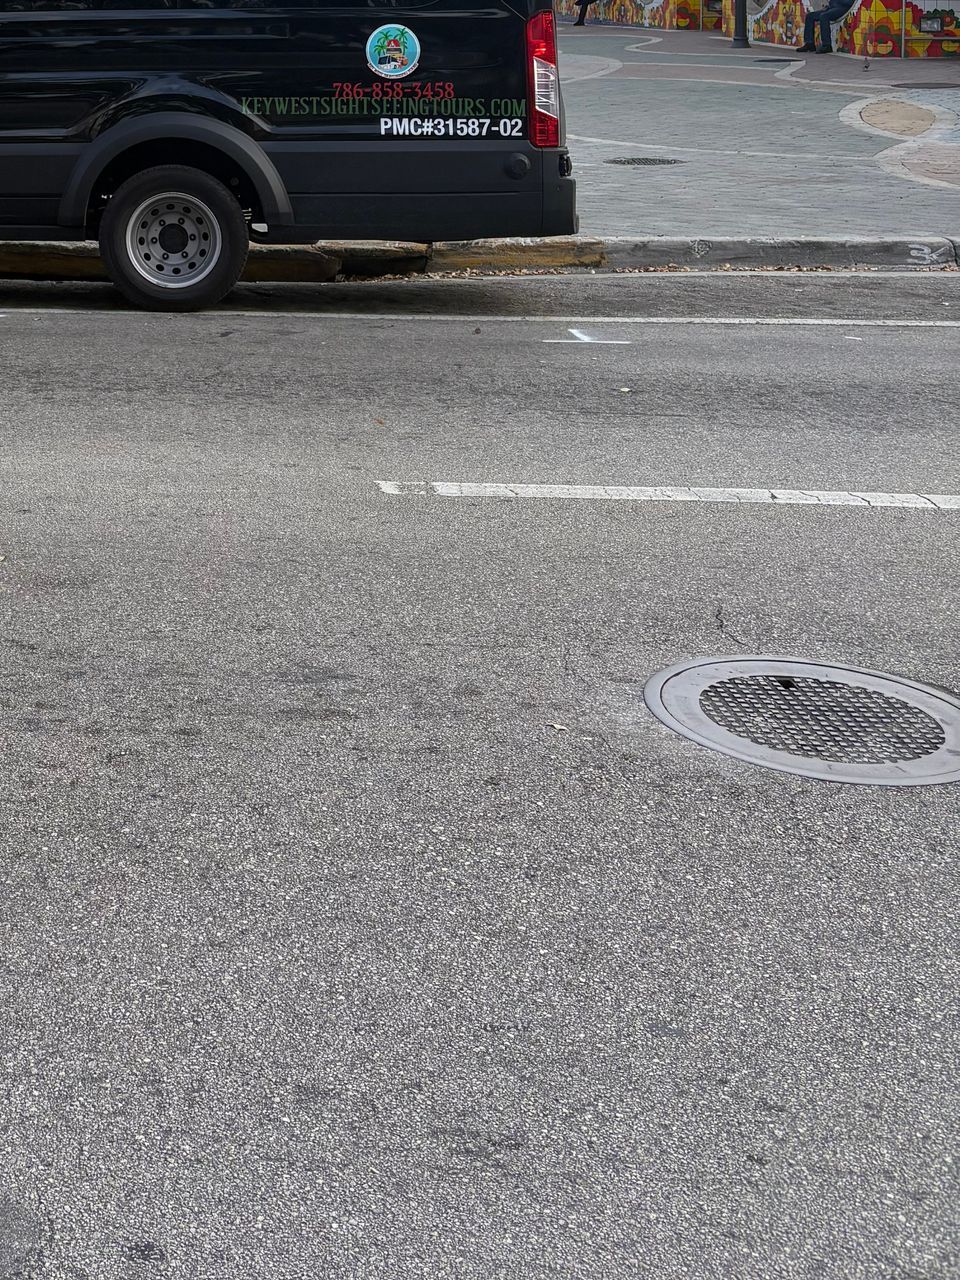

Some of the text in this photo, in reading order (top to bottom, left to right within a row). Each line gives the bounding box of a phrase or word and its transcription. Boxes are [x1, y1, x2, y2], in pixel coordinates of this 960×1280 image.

[332, 82, 455, 100] 786-858-3458
[241, 96, 527, 117] KEYWESTSIGHTSEEINGTOURS.COM
[379, 117, 523, 137] PMC#31587-02
